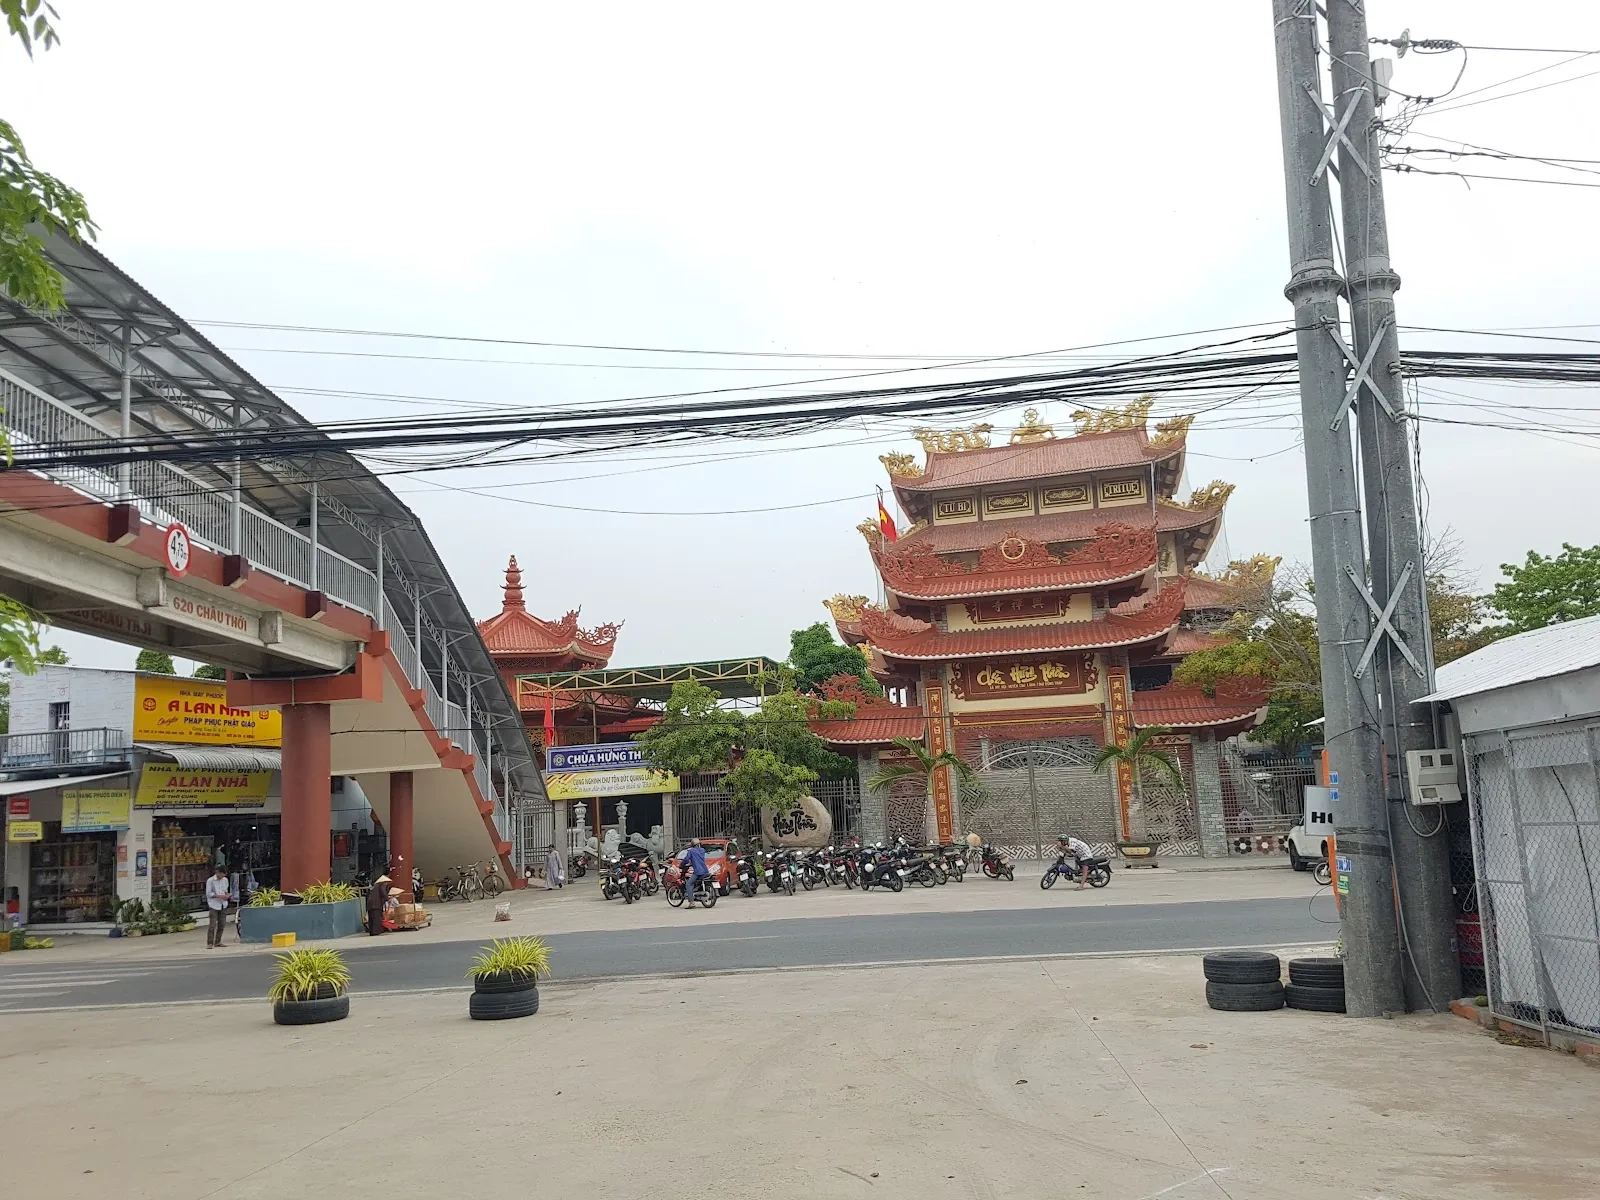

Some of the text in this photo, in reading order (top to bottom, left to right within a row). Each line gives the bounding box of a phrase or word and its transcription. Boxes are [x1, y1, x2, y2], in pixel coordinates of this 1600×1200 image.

[173, 596, 248, 632] 620 CHÂU THỚI
[168, 700, 180, 712] A
[184, 701, 215, 715] LAN
[183, 715, 203, 725] PHÁP
[204, 718, 222, 728] PHỤC
[223, 717, 239, 729] PHẬT
[241, 717, 255, 728] GIÁO
[567, 751, 597, 764] CHÙA
[597, 749, 627, 762] HƯNG
